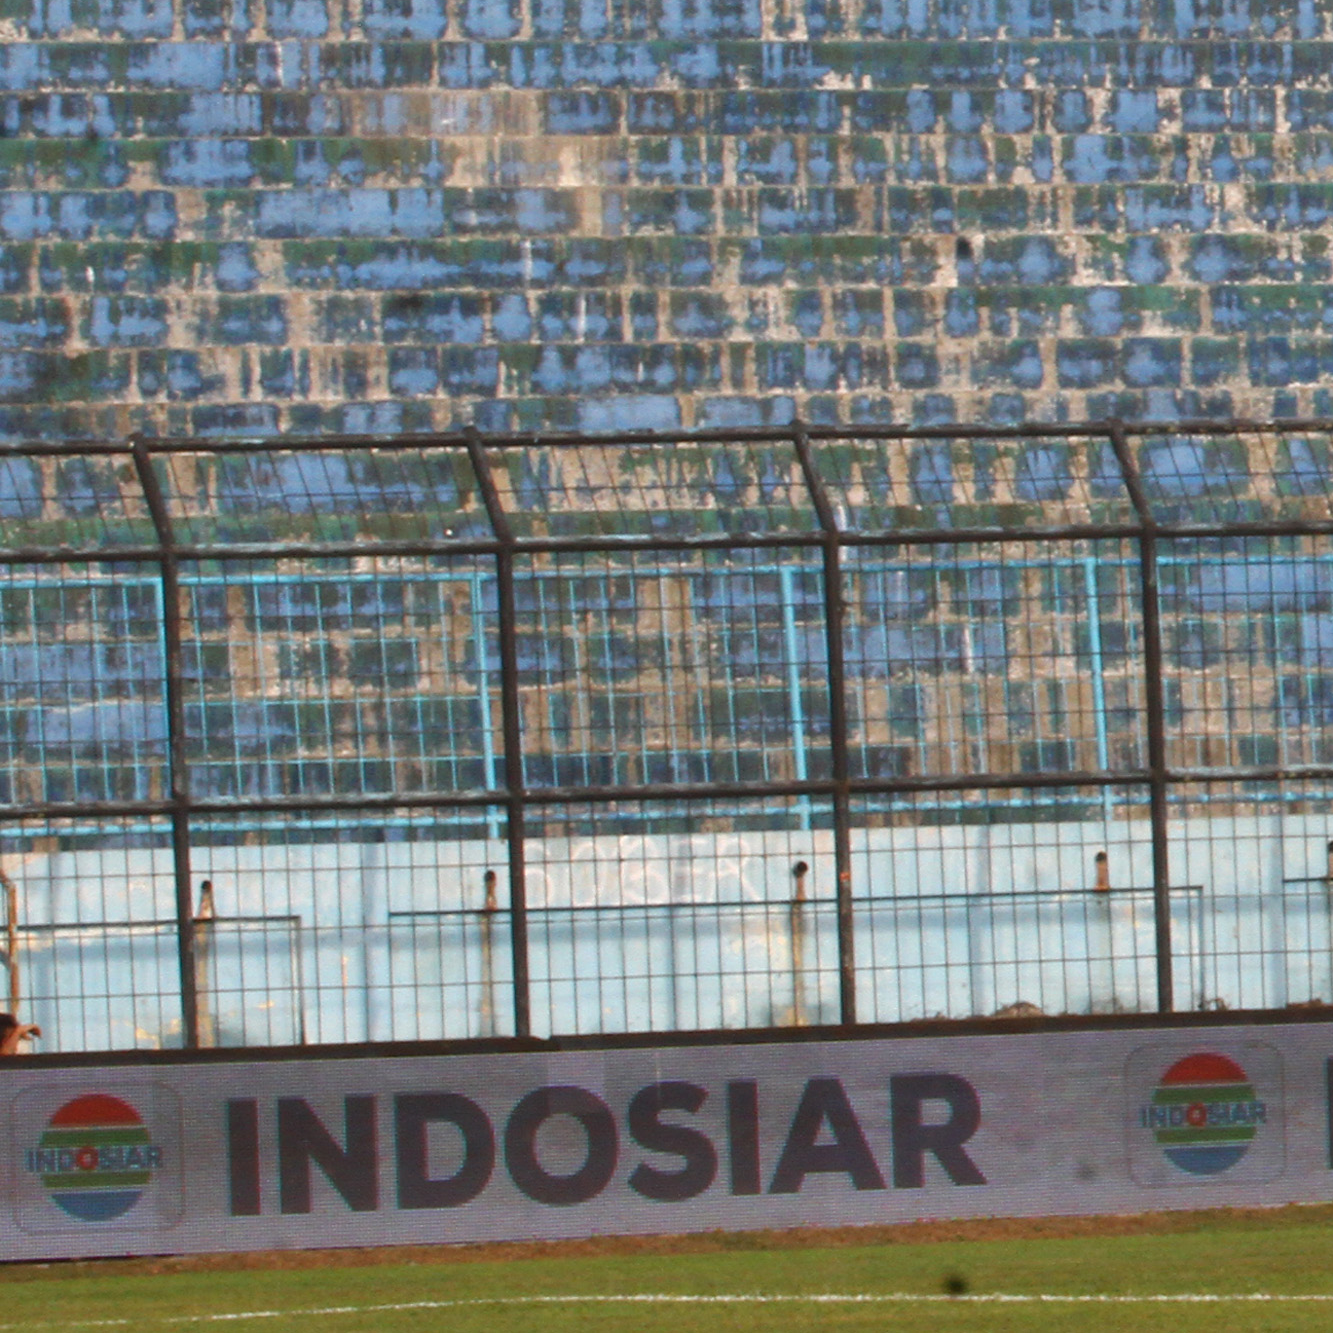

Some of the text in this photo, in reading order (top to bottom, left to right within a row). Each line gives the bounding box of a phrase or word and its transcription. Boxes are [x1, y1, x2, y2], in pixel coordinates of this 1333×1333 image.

[1140, 1102, 1267, 1129] INDOSIAR
[27, 1144, 163, 1174] INDOSIAR
[227, 1072, 988, 1216] INDOSIAR
